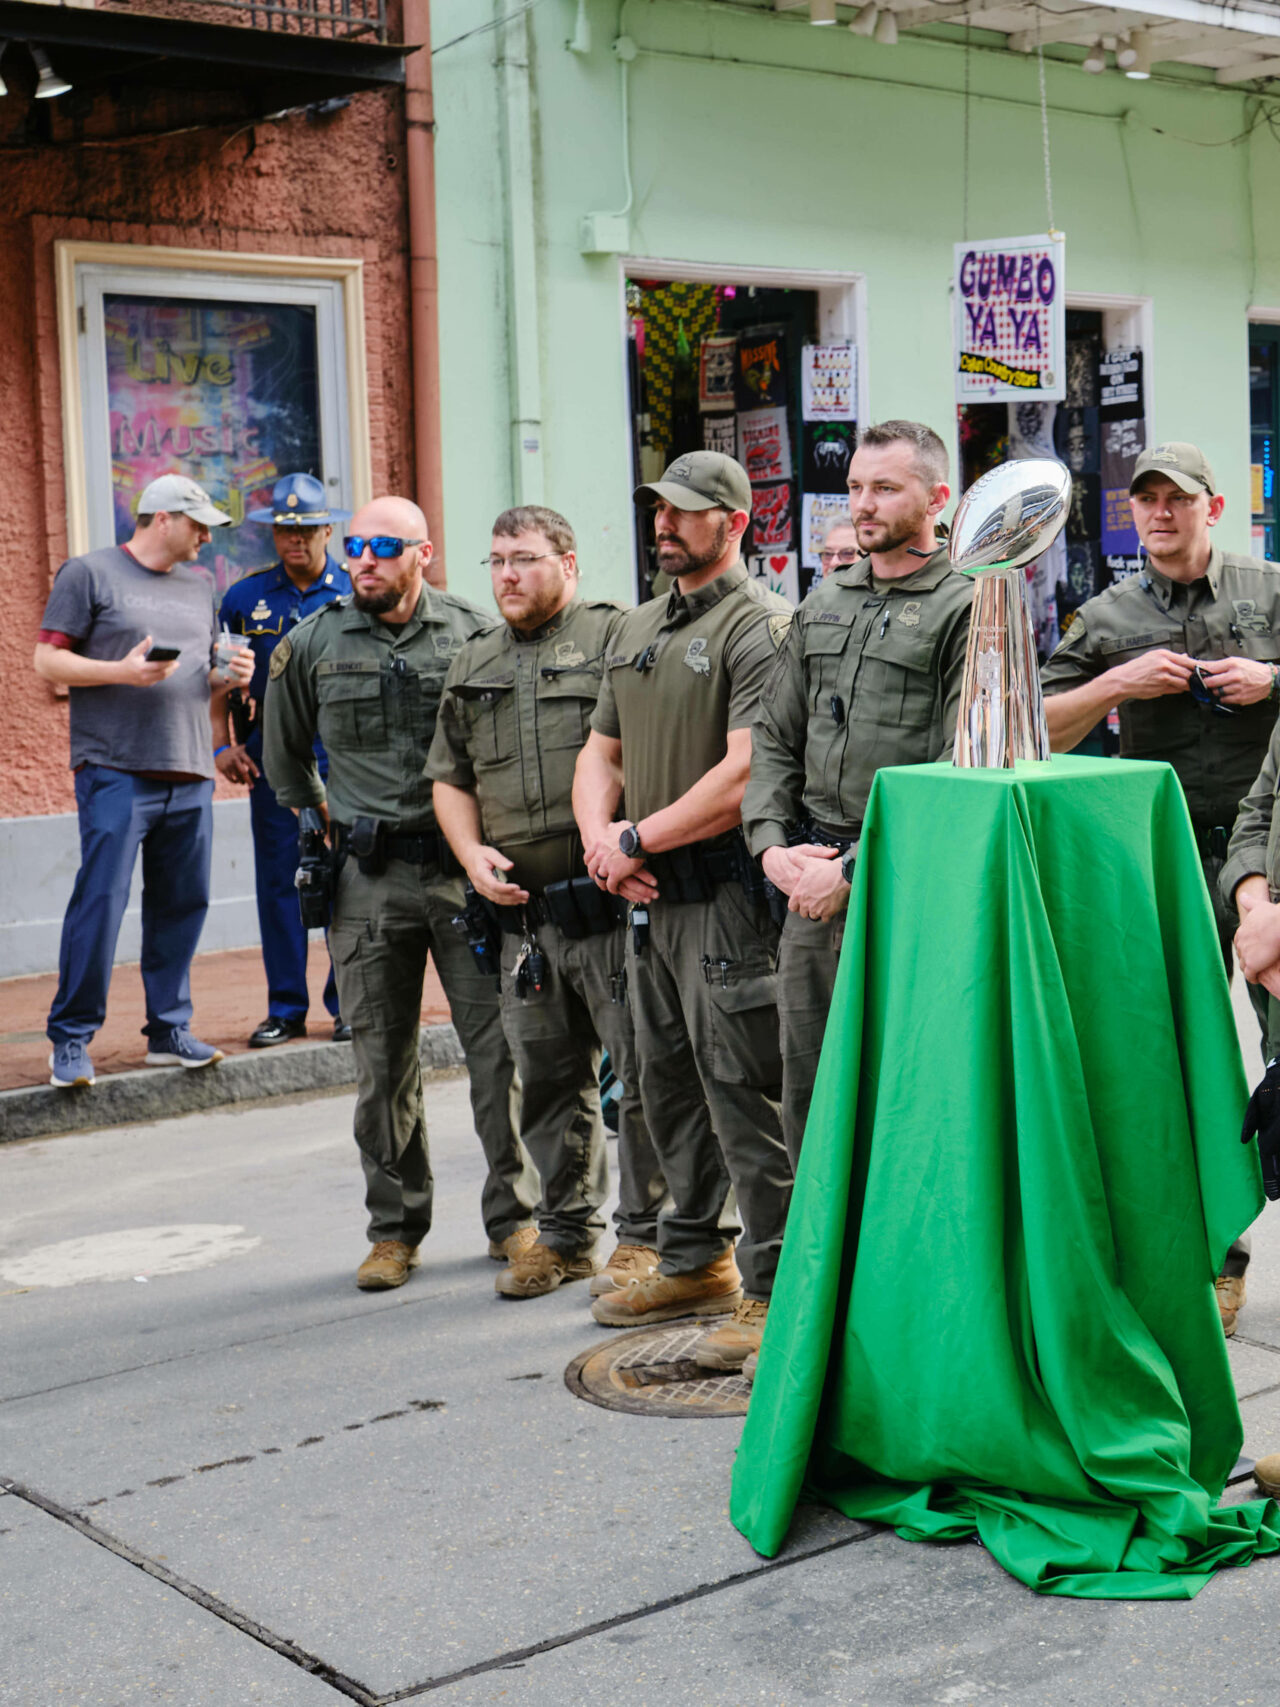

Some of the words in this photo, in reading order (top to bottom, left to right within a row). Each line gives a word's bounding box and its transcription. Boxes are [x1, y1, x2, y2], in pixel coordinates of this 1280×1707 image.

[960, 251, 1056, 306] GUMBO
[965, 302, 998, 348] YA
[1008, 307, 1042, 354] YA
[125, 337, 236, 386] Live
[961, 354, 984, 372] Cajun
[109, 409, 261, 457] Music
[755, 557, 767, 578] I
